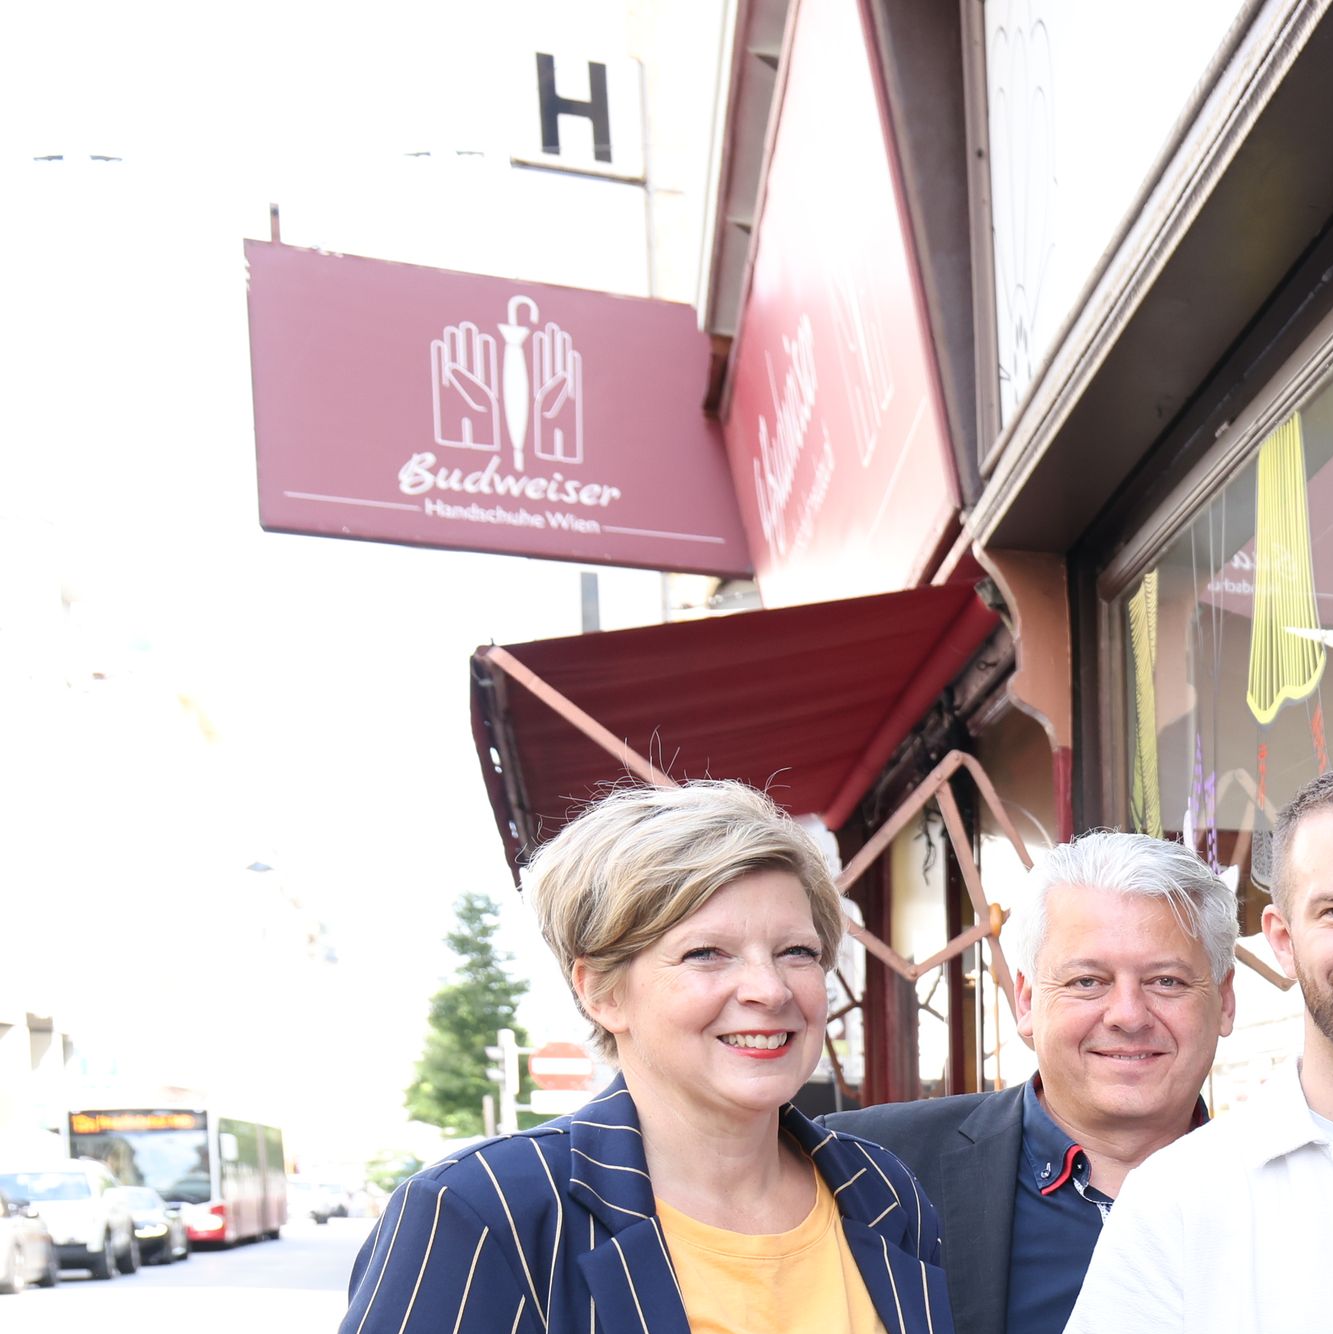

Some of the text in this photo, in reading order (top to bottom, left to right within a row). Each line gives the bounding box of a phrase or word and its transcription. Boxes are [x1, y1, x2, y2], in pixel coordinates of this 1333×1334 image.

[535, 51, 613, 163] H
[398, 451, 622, 507] Budweiser
[424, 498, 602, 535] Handschuhe Wien
